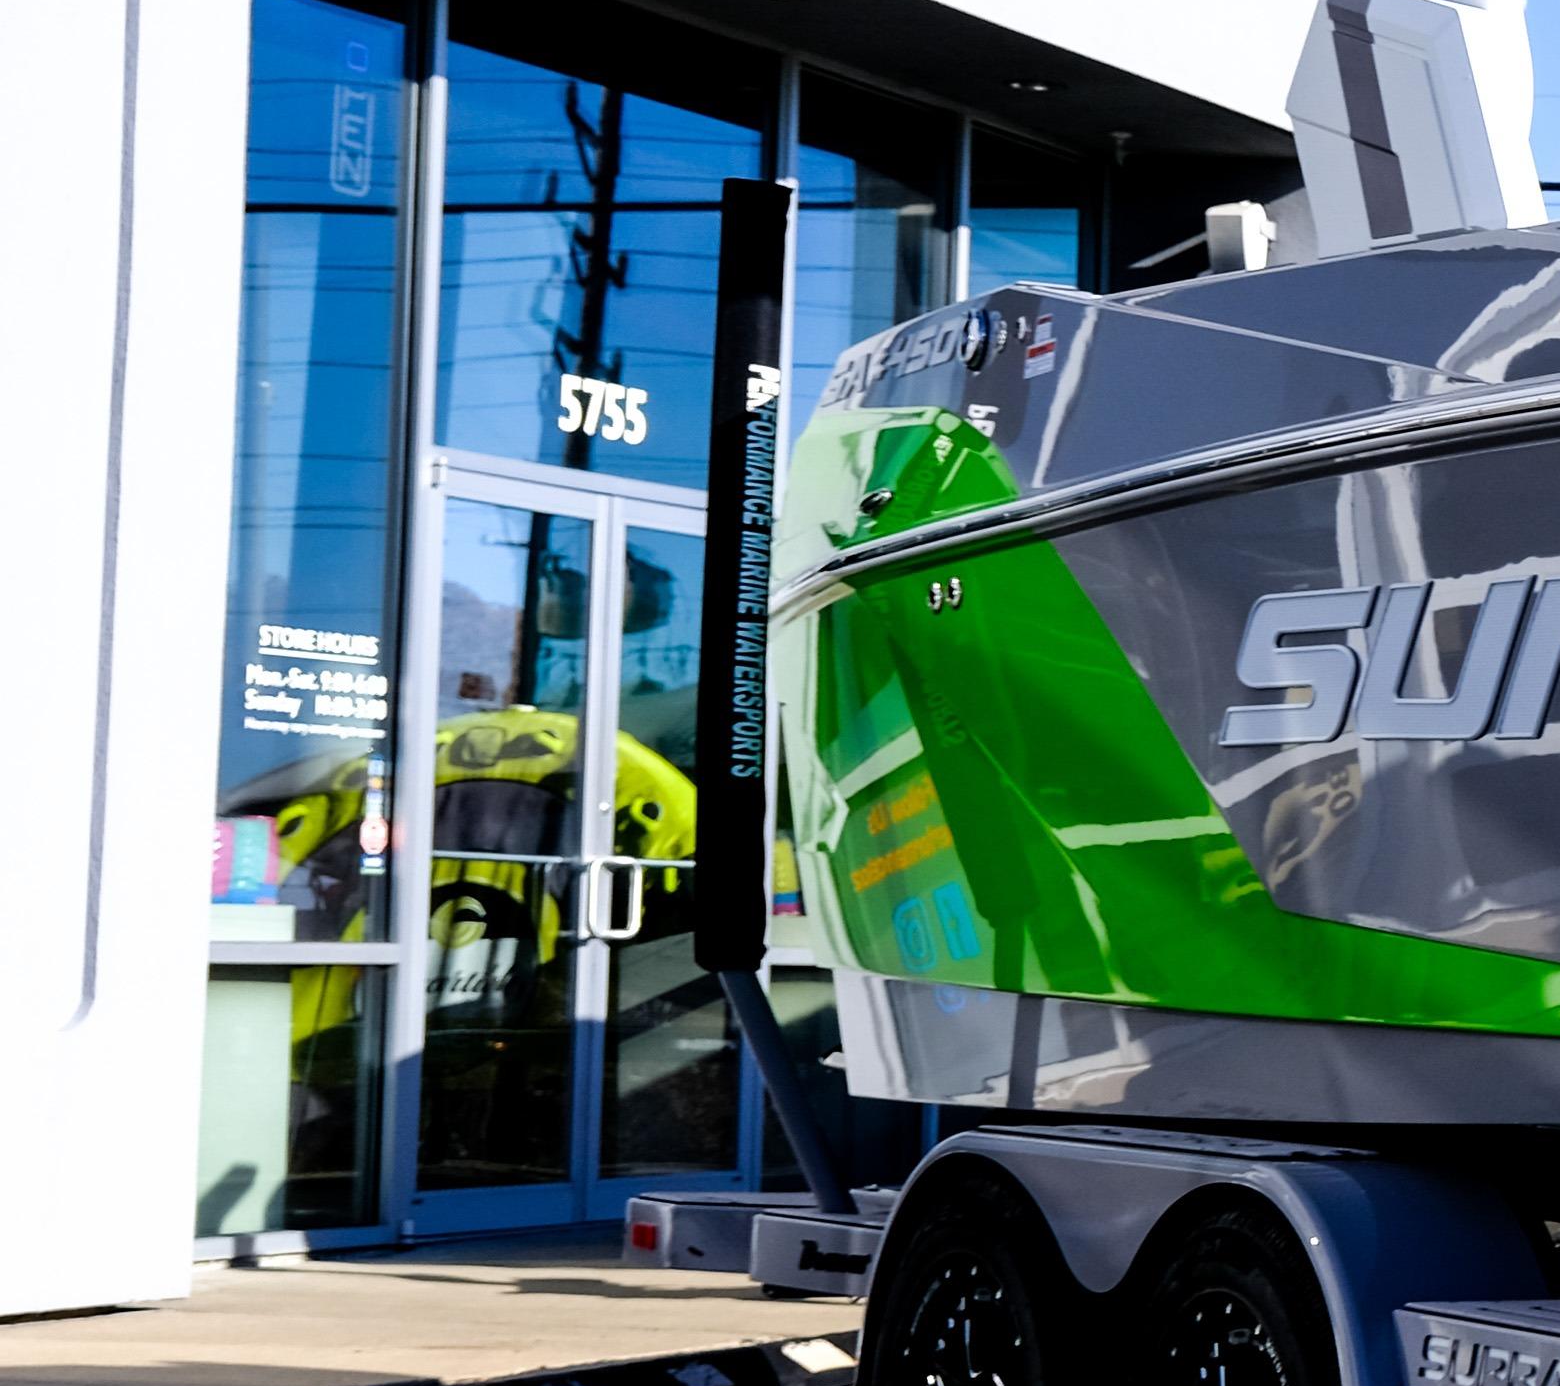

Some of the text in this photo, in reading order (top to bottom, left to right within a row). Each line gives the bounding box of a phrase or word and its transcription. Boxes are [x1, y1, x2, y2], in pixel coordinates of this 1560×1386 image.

[556, 374, 649, 445] 5755
[730, 362, 781, 781] PERFORMANCE MARINE WATERSPORTS
[259, 625, 379, 657] STORE HOURS
